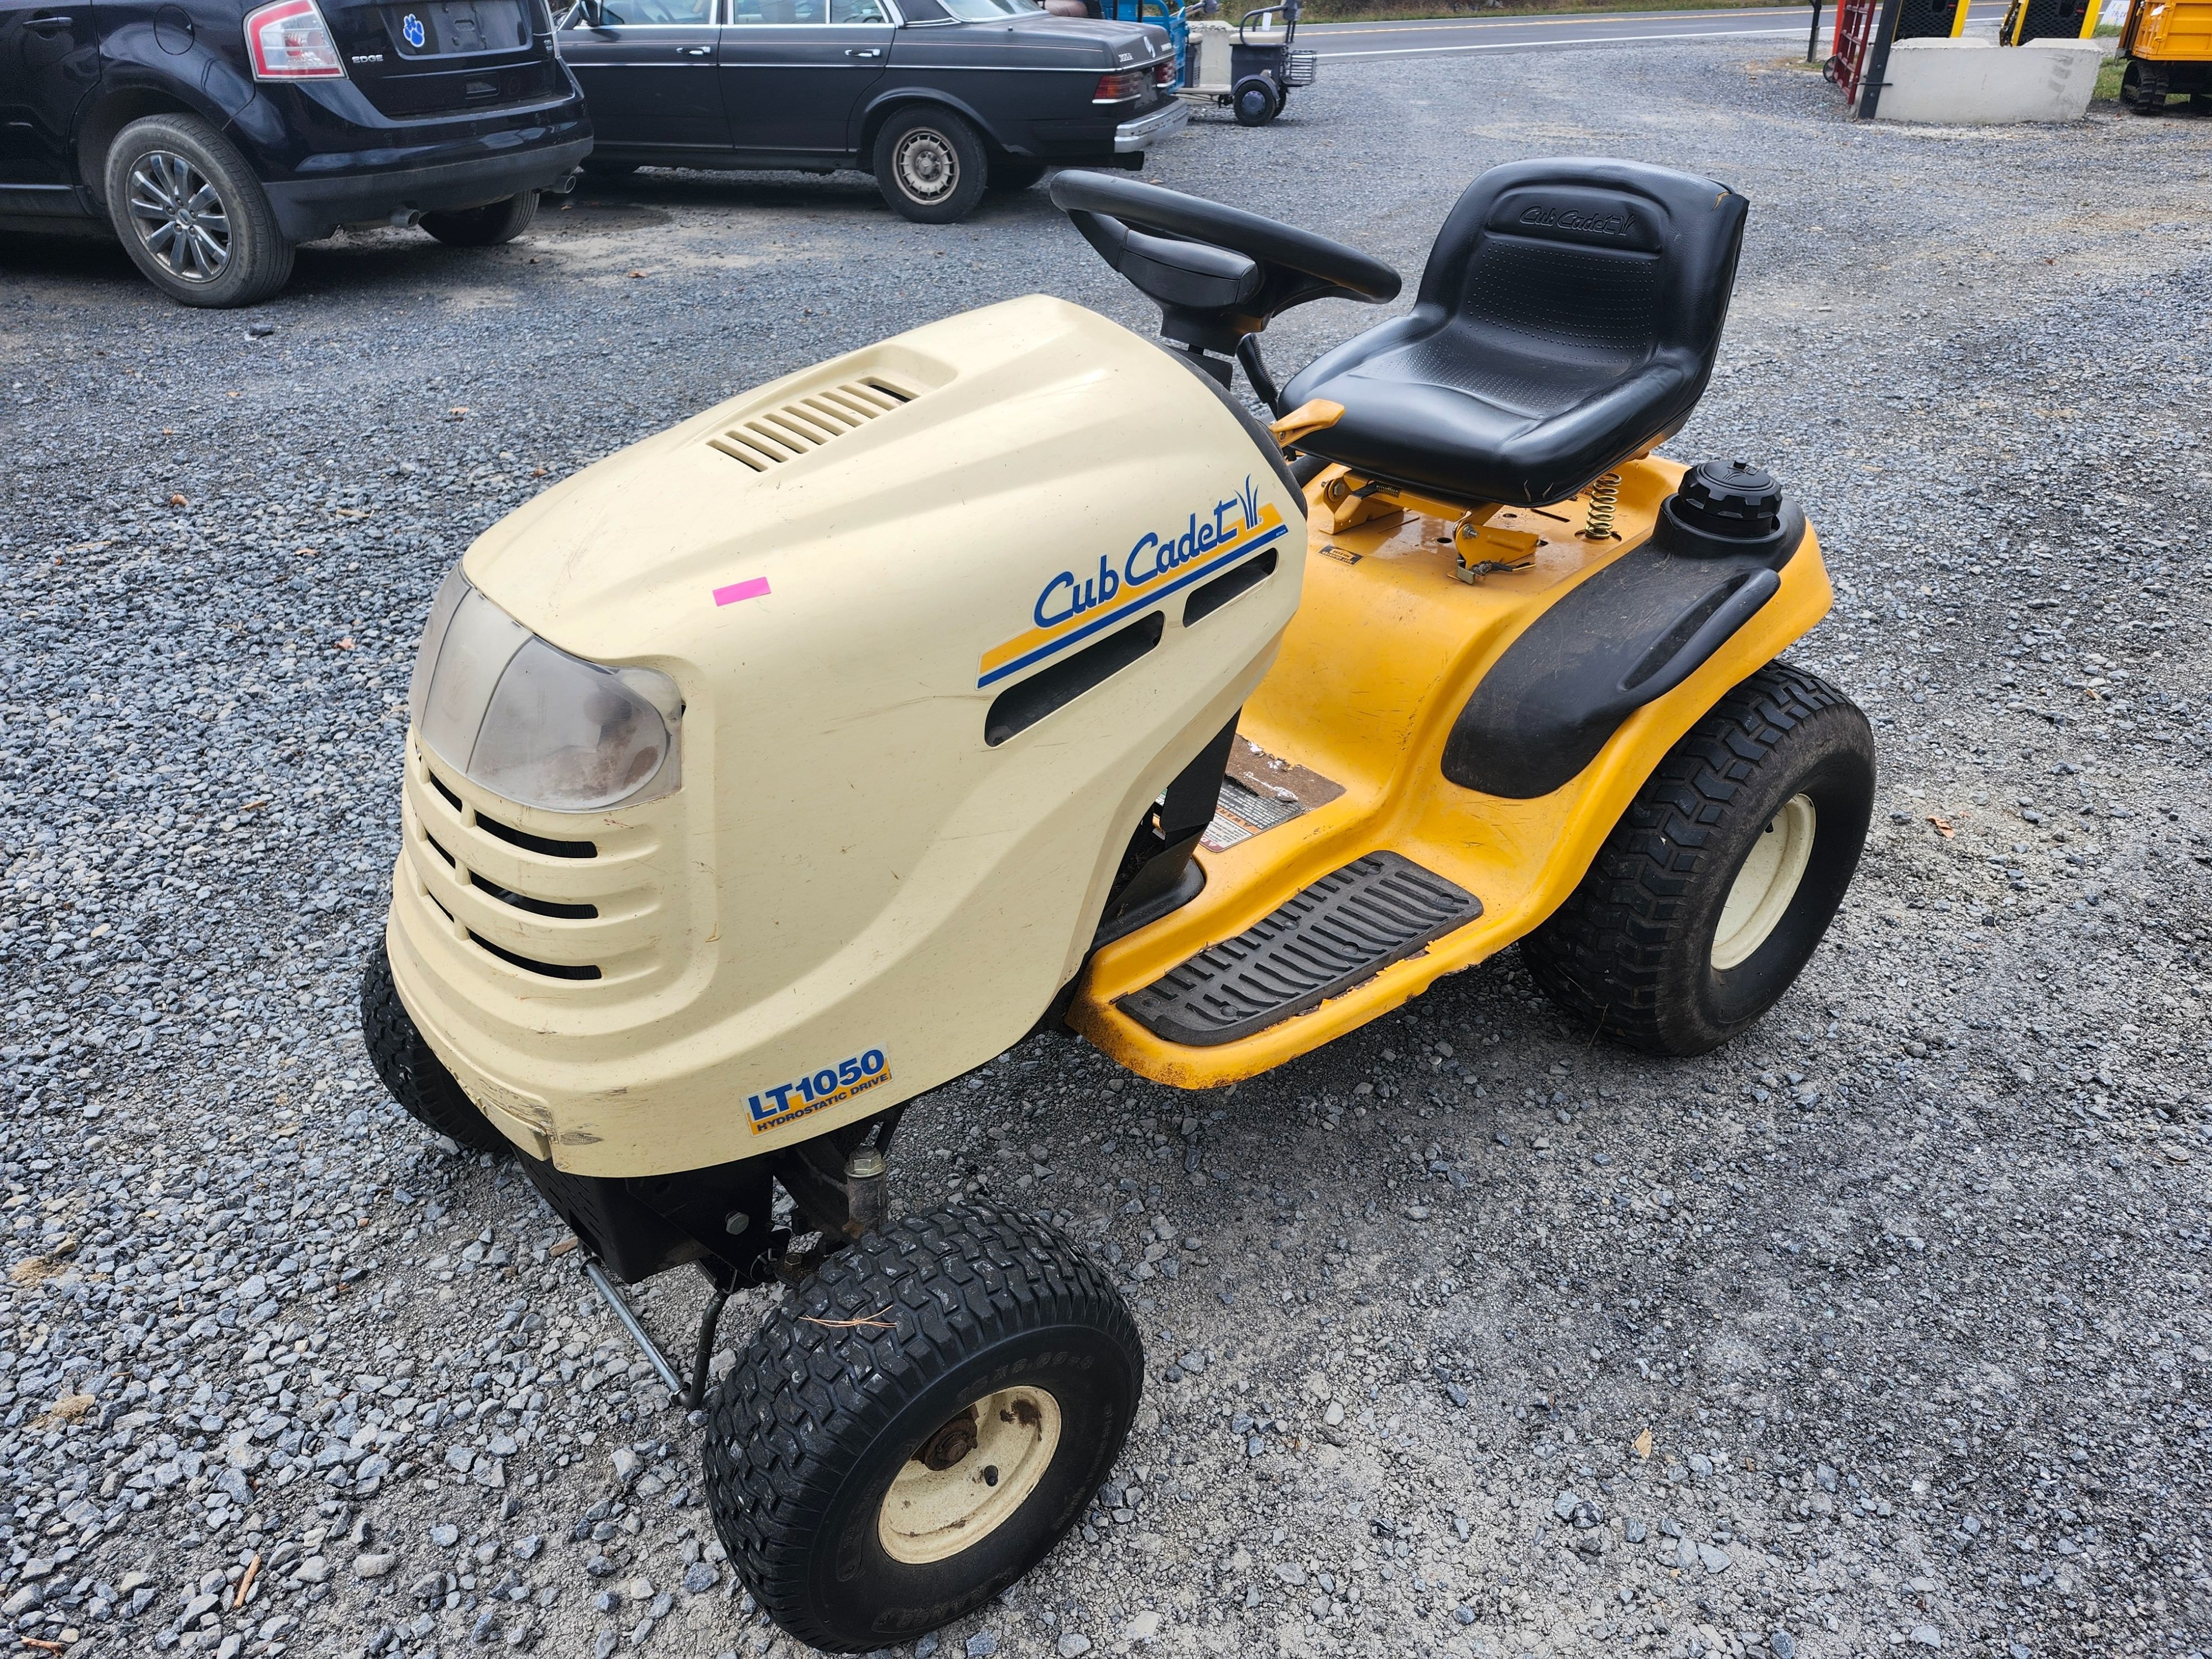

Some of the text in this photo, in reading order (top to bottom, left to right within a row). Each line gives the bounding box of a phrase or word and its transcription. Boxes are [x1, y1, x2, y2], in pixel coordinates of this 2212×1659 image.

[352, 54, 384, 63] EDGE
[1520, 206, 1620, 234] Cub Cadet
[1034, 498, 1238, 628] Cub Cadet
[1245, 817, 1259, 826] AVOID
[748, 1049, 884, 1121] LT1050
[757, 1073, 889, 1131] HYDROSTATIC DRIVE
